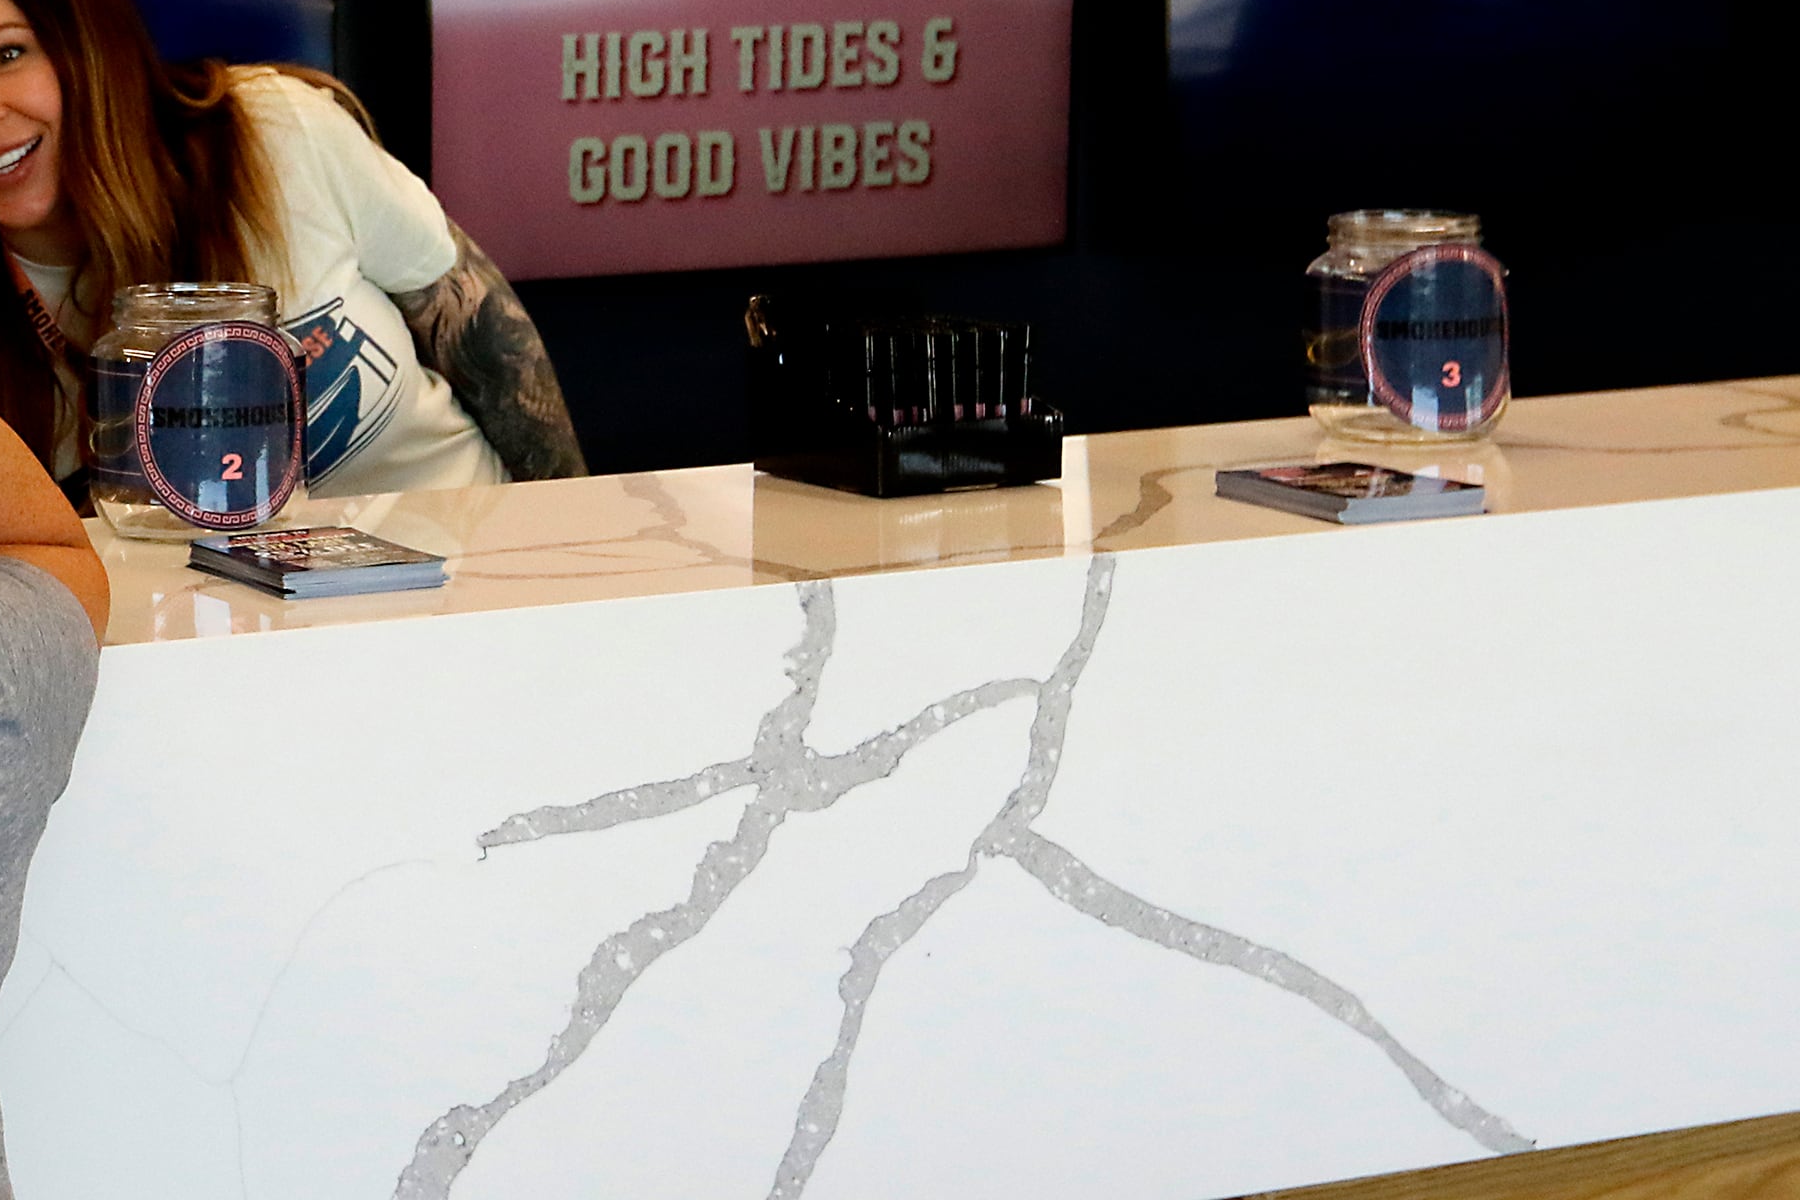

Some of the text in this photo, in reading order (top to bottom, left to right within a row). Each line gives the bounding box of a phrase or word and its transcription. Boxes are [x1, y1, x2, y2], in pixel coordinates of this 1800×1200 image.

[561, 17, 958, 101] HIGH TIDES &
[568, 120, 933, 205] GOOD VIBES
[1441, 360, 1462, 388] 3
[221, 453, 244, 480] 2
